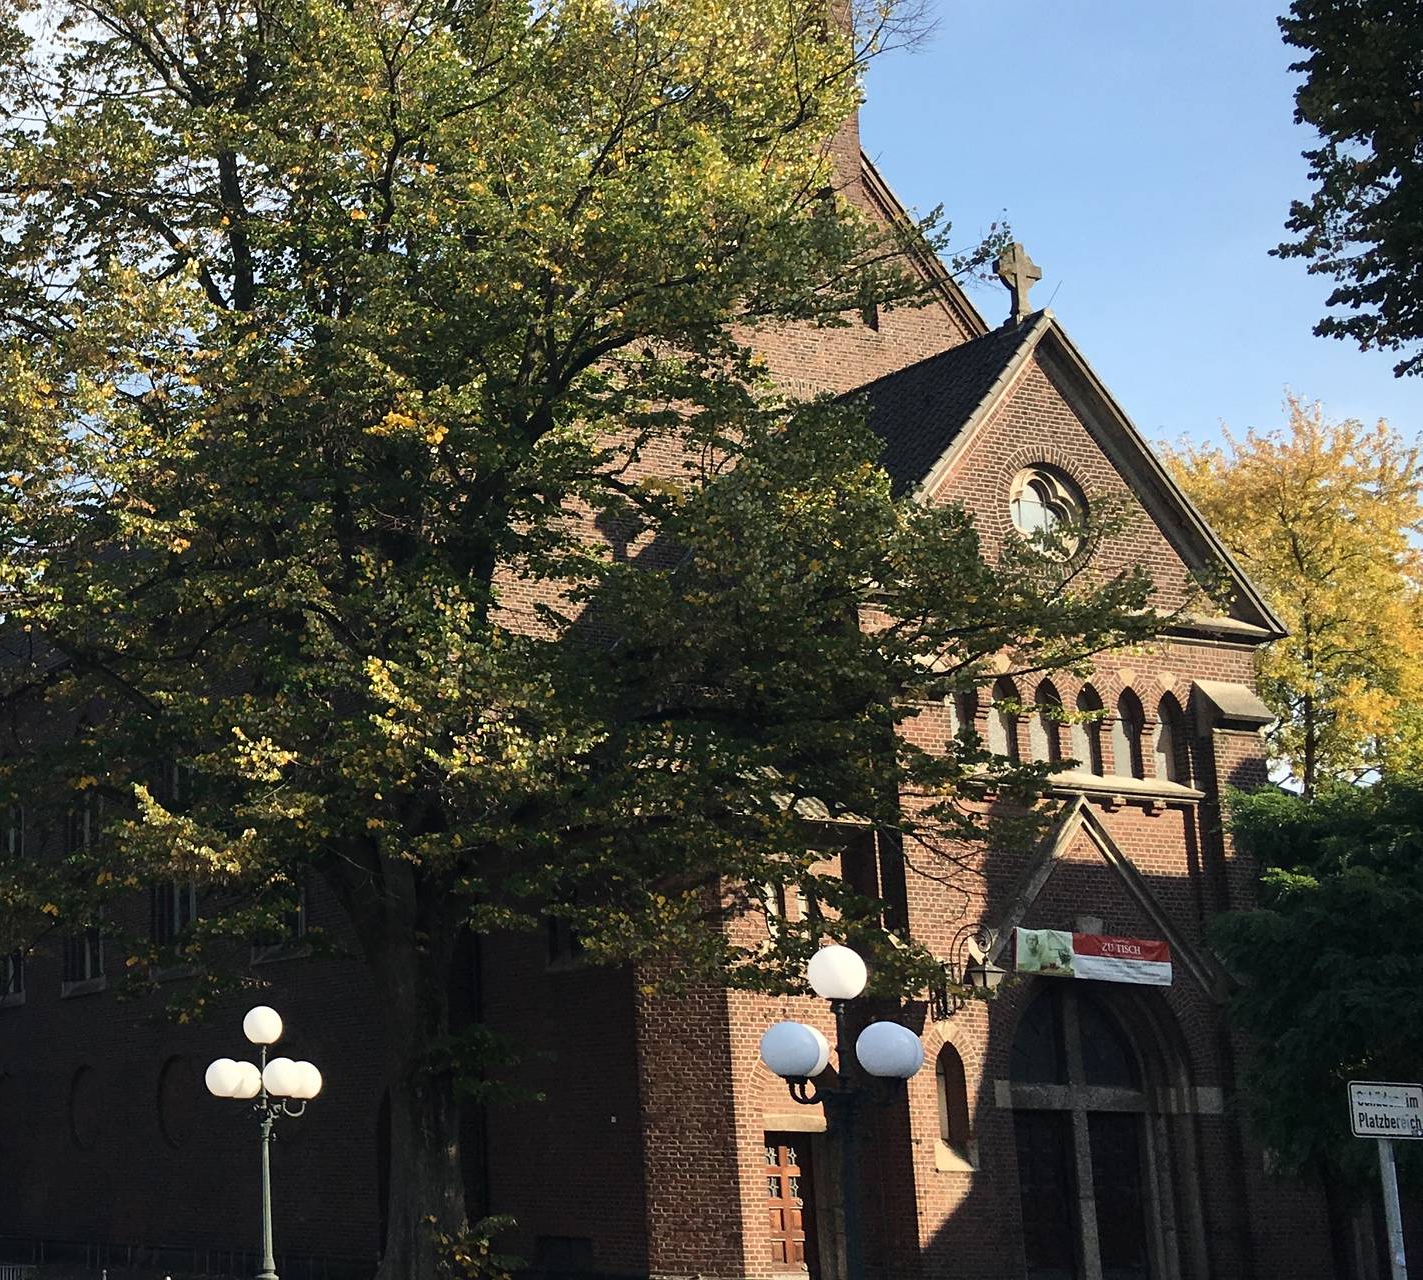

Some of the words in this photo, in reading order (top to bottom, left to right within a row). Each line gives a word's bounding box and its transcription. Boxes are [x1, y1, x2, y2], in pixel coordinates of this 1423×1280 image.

[1102, 942, 1114, 952] ZU
[1117, 943, 1141, 954] TISCH
[1405, 1093, 1418, 1108] im
